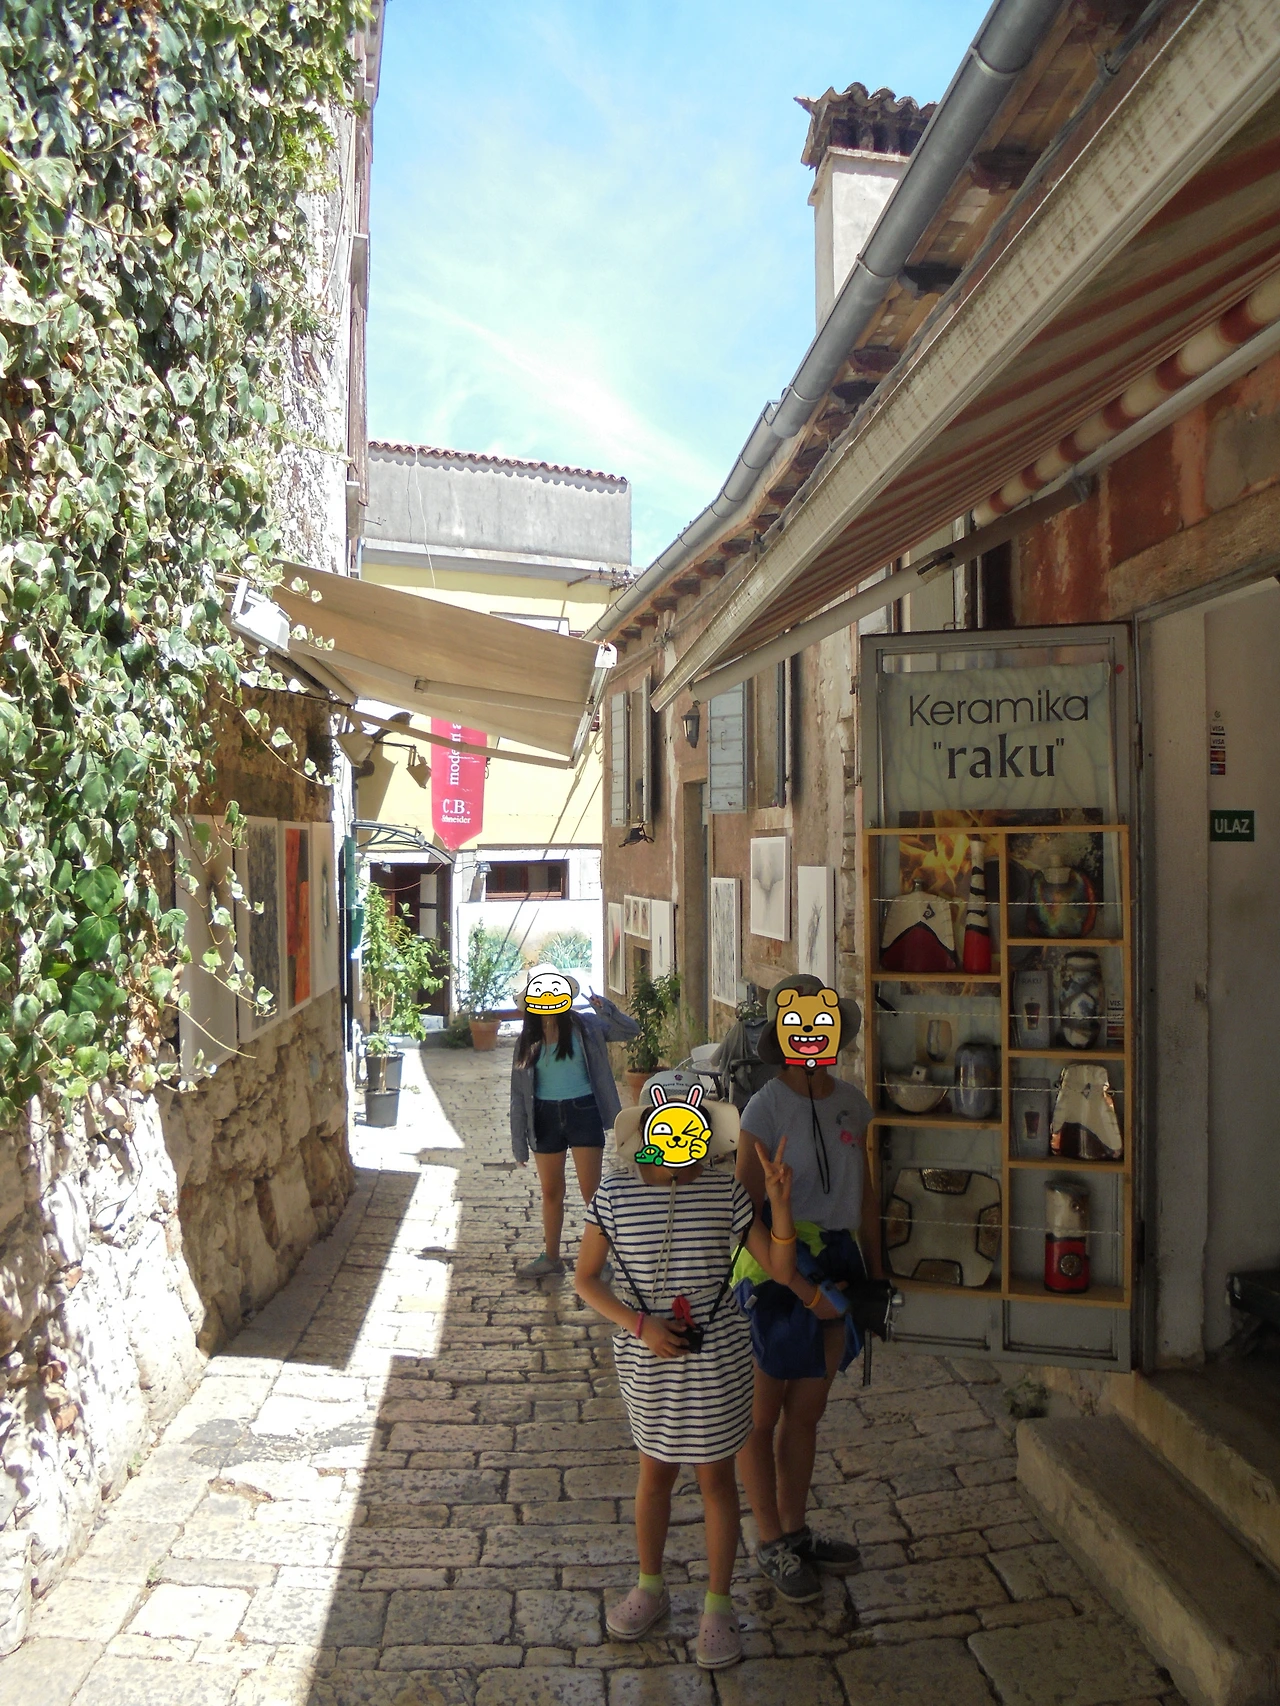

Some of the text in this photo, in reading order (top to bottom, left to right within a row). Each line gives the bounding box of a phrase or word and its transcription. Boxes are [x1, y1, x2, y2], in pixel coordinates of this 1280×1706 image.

[909, 689, 1089, 727] Keramika
[448, 732, 461, 786] moden
[933, 733, 1065, 780] "raku"
[442, 798, 471, 815] C.B.
[1214, 818, 1250, 834] ULAZ
